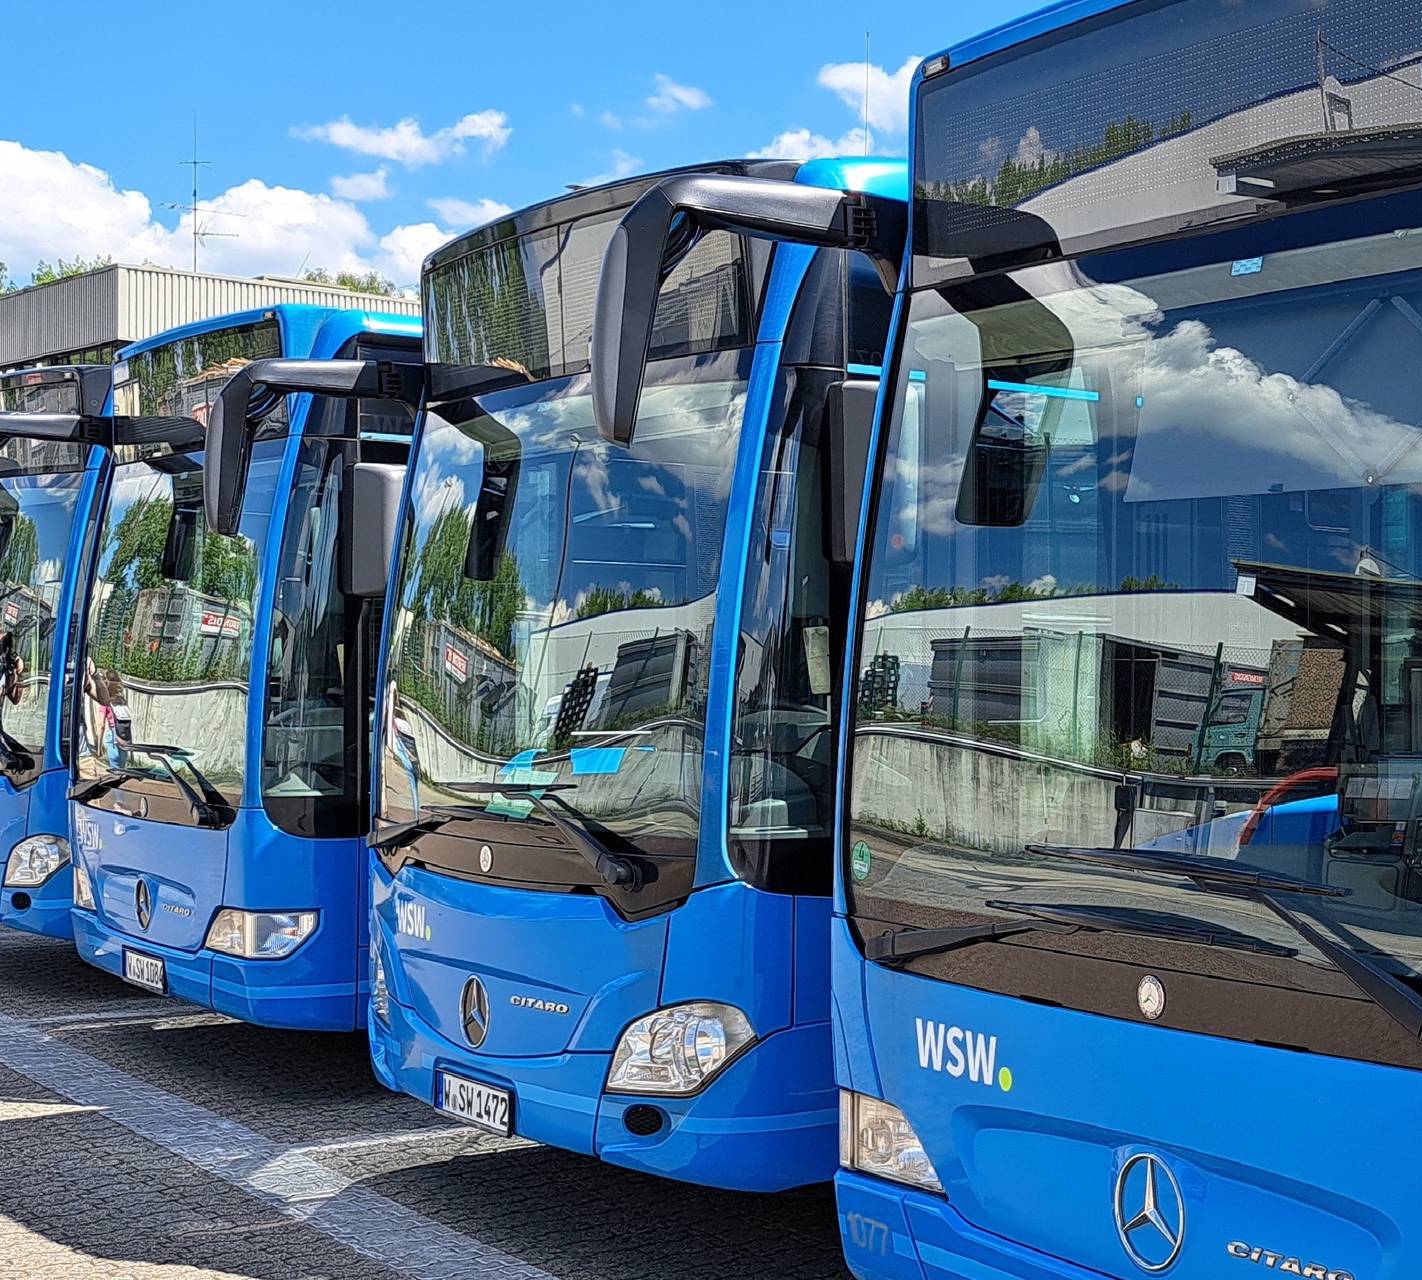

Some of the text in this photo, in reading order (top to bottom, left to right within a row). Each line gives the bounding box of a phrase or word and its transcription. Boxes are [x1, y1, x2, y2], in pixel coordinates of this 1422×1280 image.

[858, 843, 865, 861] 4
[162, 903, 192, 918] CITARO
[510, 994, 570, 1014] CITARO
[847, 1210, 890, 1258] 1077
[1226, 1240, 1356, 1280] CITARO
